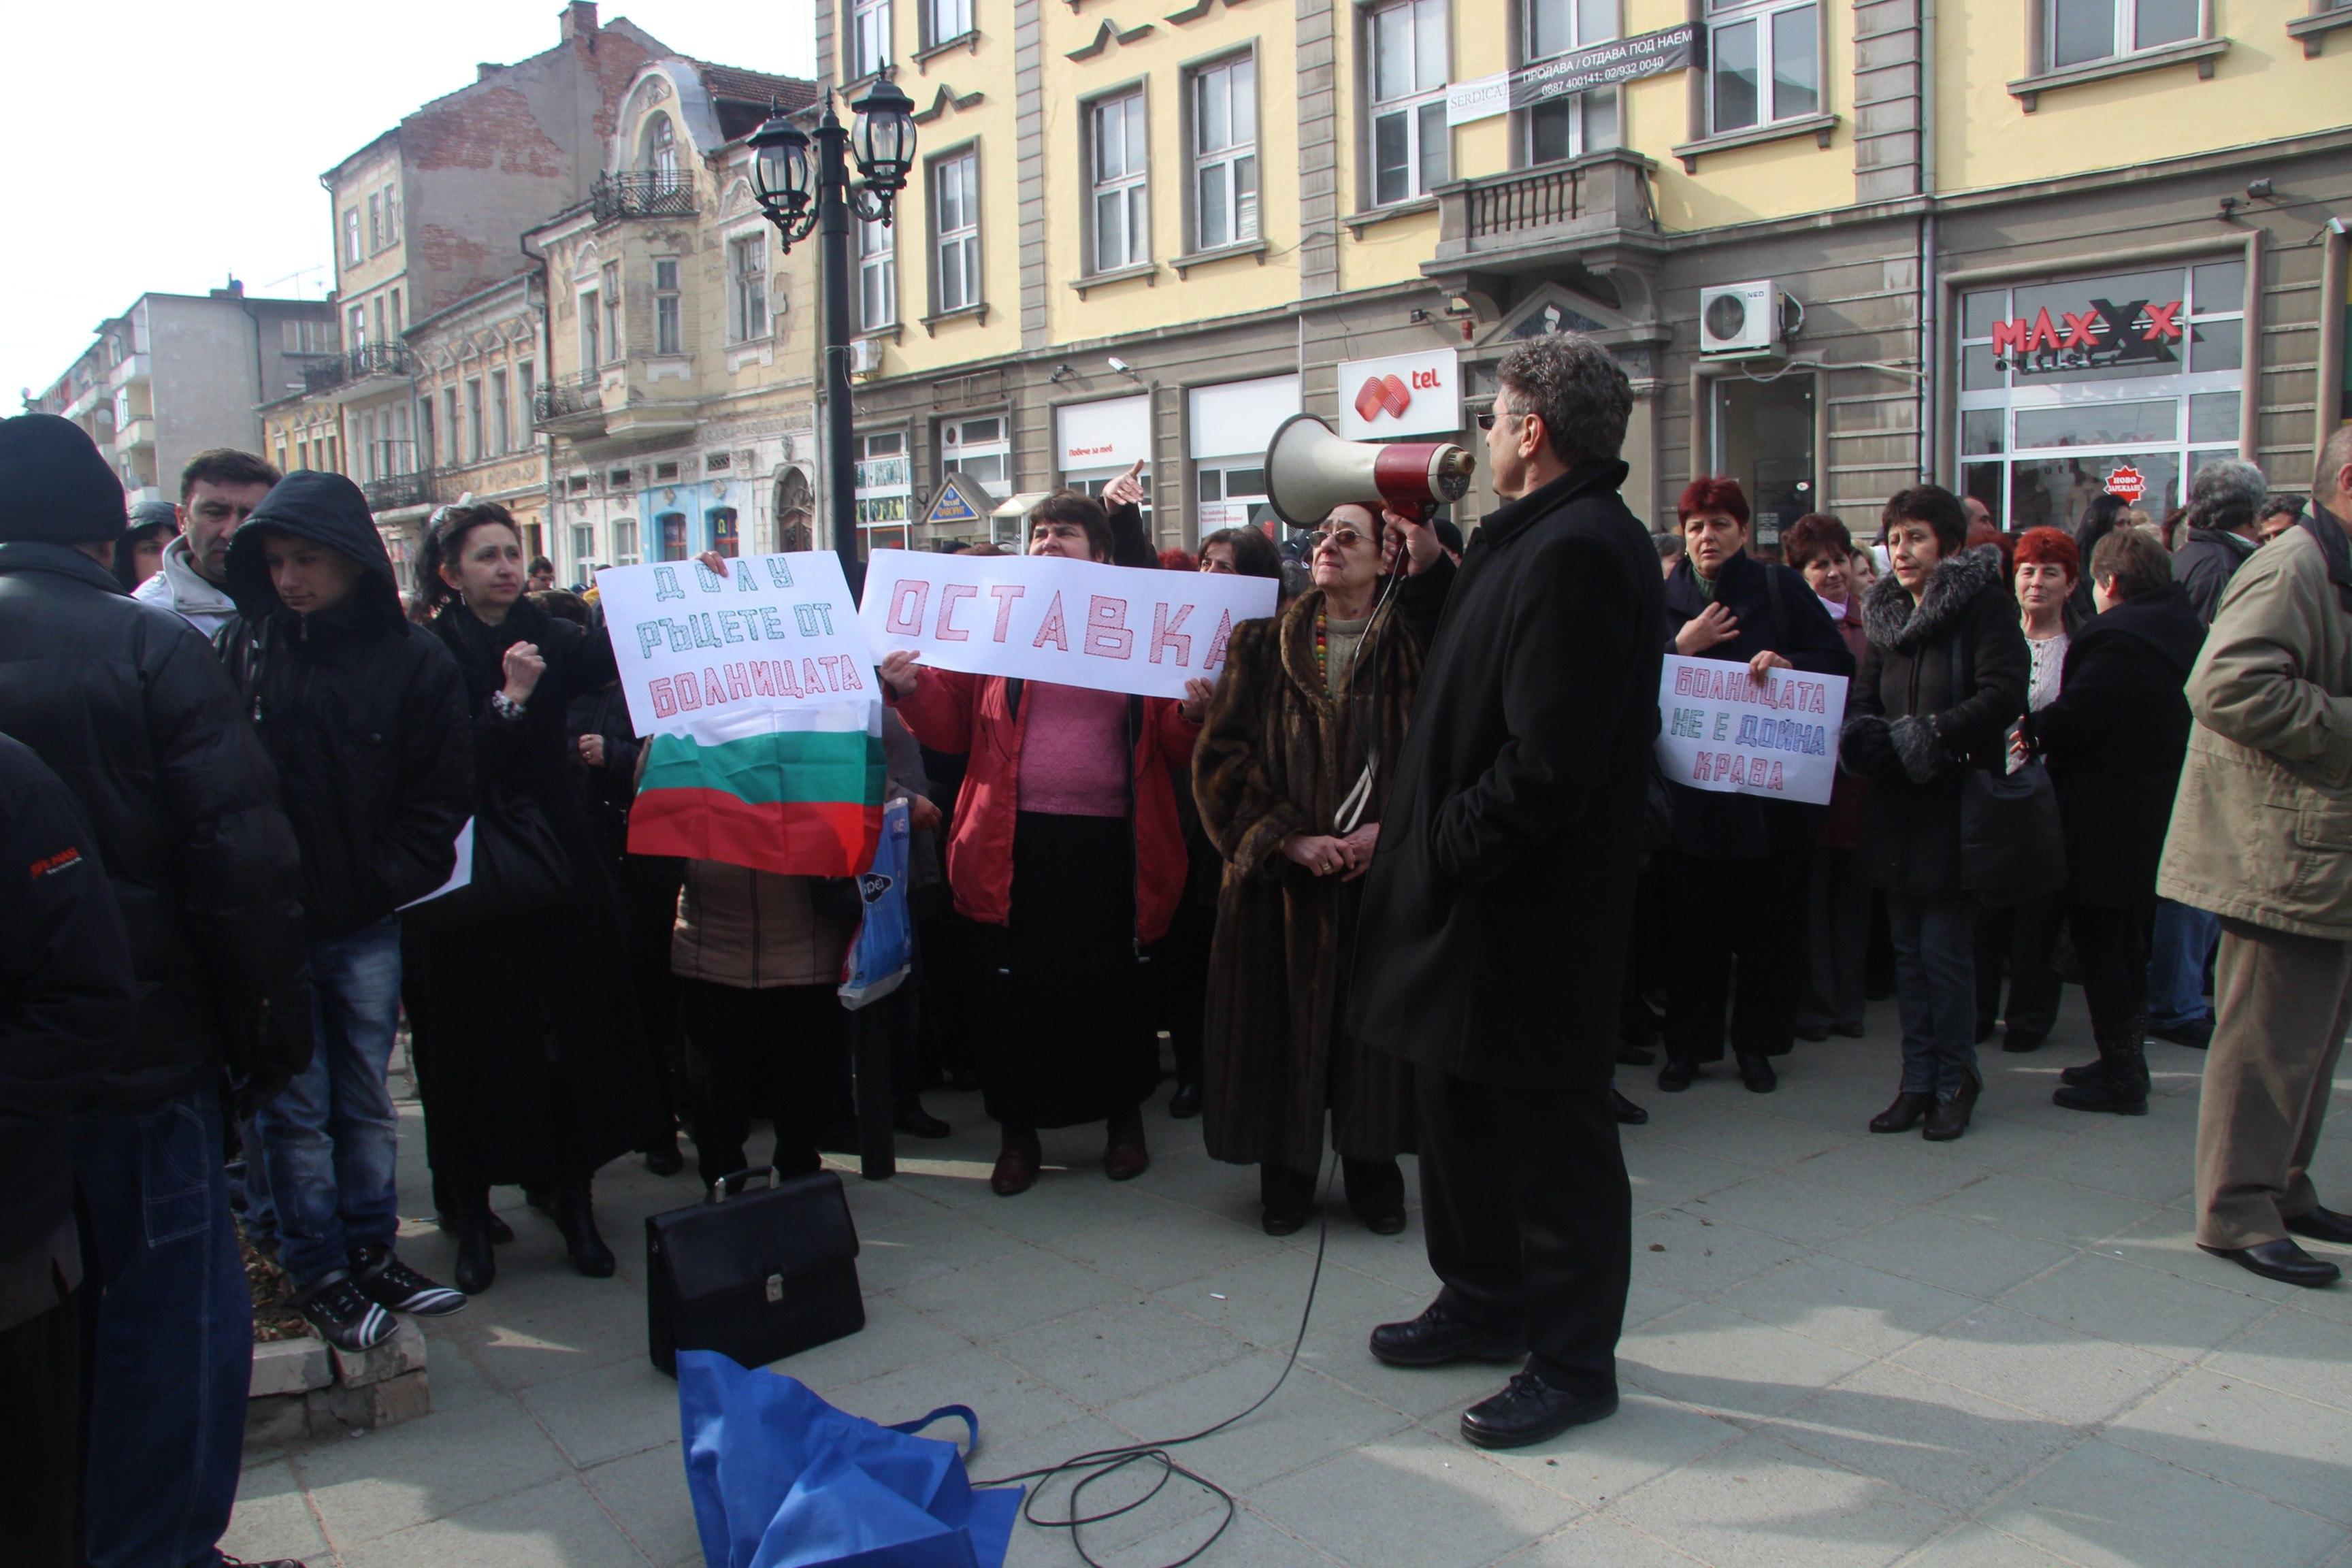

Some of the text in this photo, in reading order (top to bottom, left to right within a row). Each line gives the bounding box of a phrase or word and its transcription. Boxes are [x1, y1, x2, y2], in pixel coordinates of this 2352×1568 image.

[1522, 62, 1574, 83] ПРОДАВА
[1582, 47, 1627, 67] ОТДАВА
[1629, 39, 1655, 56] ПОД
[1657, 30, 1693, 48] НАЕМ
[1541, 80, 1565, 95] 0887
[1605, 63, 1637, 80] 02/932
[1639, 56, 1665, 71] 0040
[1450, 86, 1503, 110] SERDICA
[654, 557, 794, 602] ДОЛУ
[636, 603, 836, 659] РЪЦЕТЕ ОТ
[886, 578, 1232, 670] ОСТАВКА
[649, 654, 863, 719] БОЛНИЦАТА
[1671, 708, 1826, 756] НЕ Е ДОЙНА
[1693, 751, 1784, 791] КРАВА
